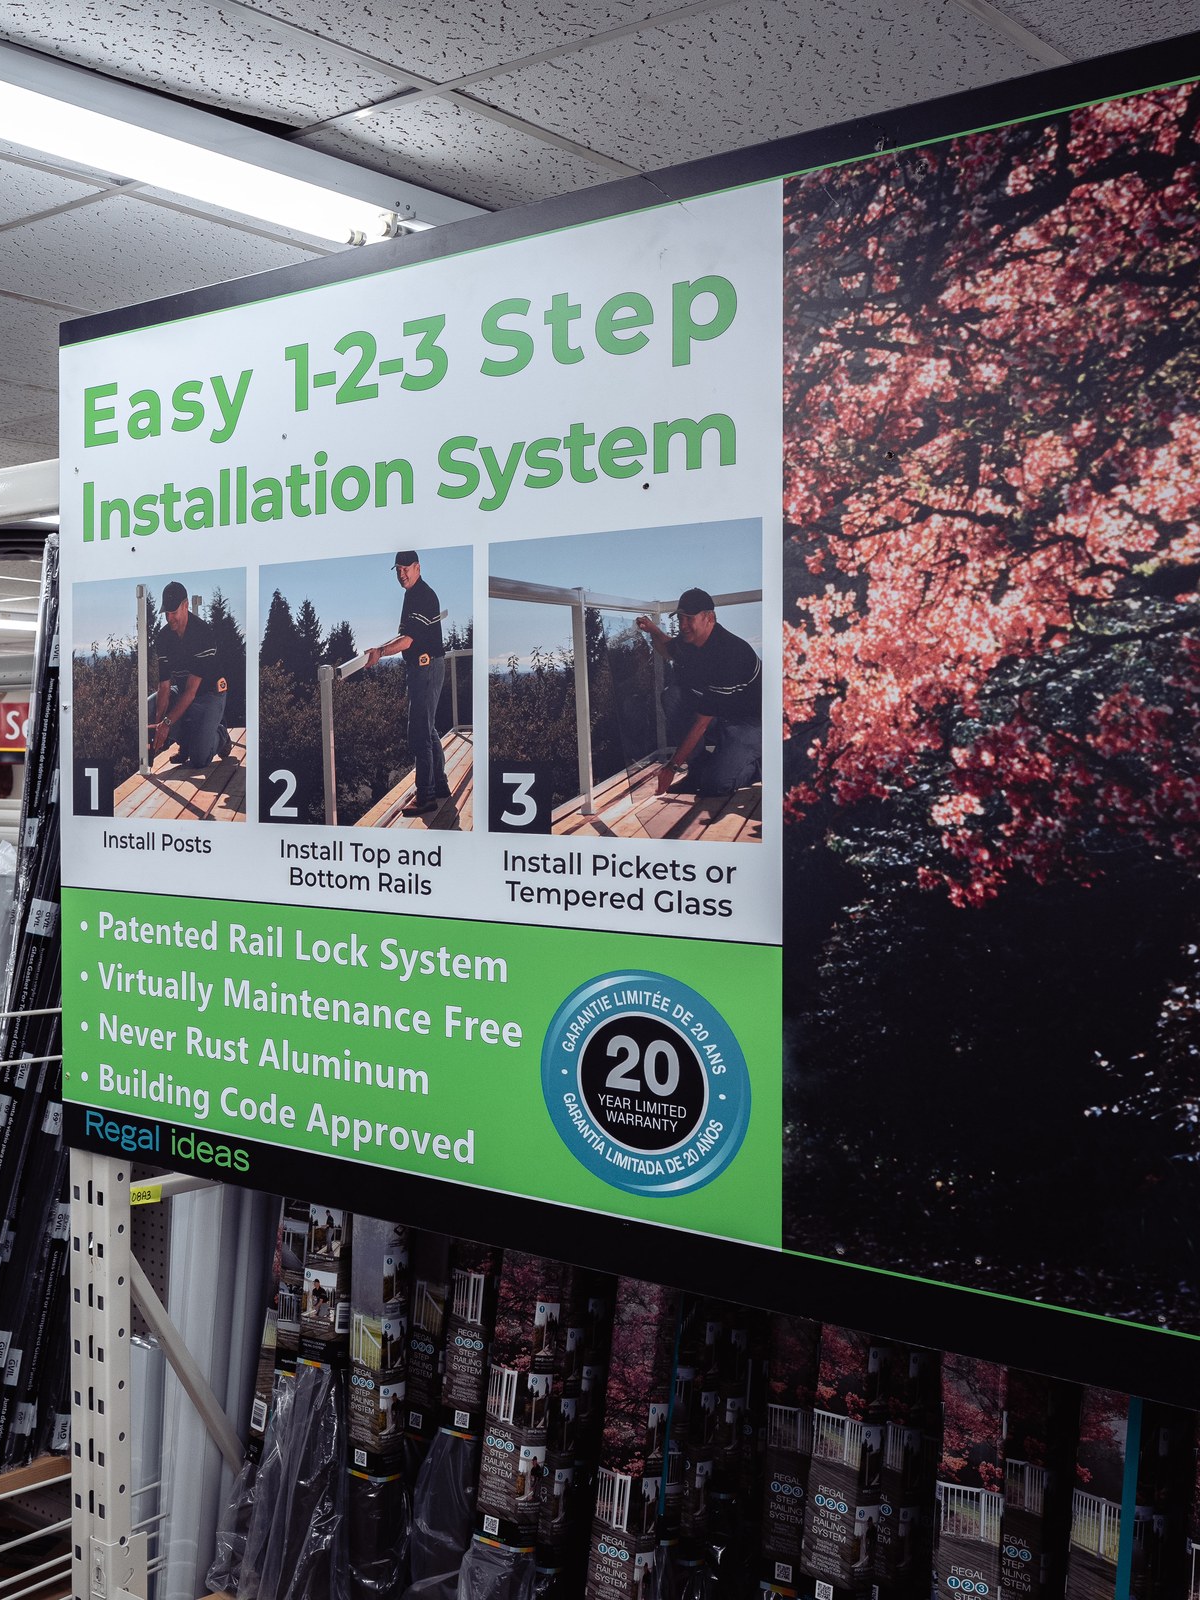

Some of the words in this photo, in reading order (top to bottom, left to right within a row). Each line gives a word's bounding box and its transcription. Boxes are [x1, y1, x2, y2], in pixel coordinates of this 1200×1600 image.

[85, 371, 252, 448] Easy
[285, 315, 448, 411] 1-2-3
[482, 277, 736, 376] Step
[84, 452, 413, 541] Installation
[439, 415, 735, 510] System
[47, 677, 55, 693] Junta
[46, 693, 53, 701] de
[43, 701, 52, 718] vidrio
[41, 718, 49, 732] para
[39, 732, 48, 754] paneles
[39, 754, 46, 763] de
[37, 762, 45, 780] vidrio
[85, 766, 101, 812] 1
[268, 770, 299, 818] 2
[501, 772, 538, 827] 3
[104, 831, 154, 850] Install
[162, 834, 211, 853] Posts
[281, 840, 342, 861] Install
[350, 843, 390, 868] Top
[398, 846, 441, 866] and
[504, 850, 581, 875] Install
[593, 854, 696, 881] Pickets
[706, 866, 736, 884] or
[290, 867, 369, 891] Bottom
[379, 873, 431, 895] Rails
[506, 881, 643, 911] Tempered
[655, 890, 732, 917] Glass
[33, 910, 42, 928] GVIL
[42, 911, 51, 929] GVIL
[27, 946, 37, 964] Glass
[100, 912, 217, 950] Patented
[230, 924, 282, 957] Rail
[297, 930, 368, 967] Lock
[381, 939, 507, 982] System
[22, 965, 34, 989] Gasket
[20, 990, 29, 1002] For
[98, 962, 213, 1007] Virtually
[225, 976, 430, 1034] Maintenance
[446, 1006, 522, 1047] Free
[562, 995, 613, 1052] GARANTIE
[614, 990, 671, 1012] LIMITÉE
[672, 1004, 694, 1025] DE
[690, 1023, 709, 1041] 20
[703, 1044, 727, 1075] ANS
[8, 1039, 19, 1059] Glass
[100, 1013, 176, 1051] Never
[187, 1027, 248, 1064] Rust
[259, 1039, 428, 1098] Aluminum
[18, 1063, 27, 1081] GVIL
[605, 1034, 680, 1096] 20
[7, 1099, 18, 1117] Junta
[598, 1094, 631, 1110] YEAR
[635, 1101, 686, 1119] LIMITED
[6, 1118, 14, 1126] de
[99, 1066, 209, 1121] Building
[221, 1087, 295, 1128] Code
[304, 1103, 474, 1167] Approved
[606, 1109, 678, 1132] WARRANTY
[2, 1126, 13, 1144] vidrio
[83, 1109, 163, 1157] Regal
[168, 1128, 253, 1175] ideas
[563, 1092, 604, 1155] GARANTÍA
[606, 1147, 665, 1175] LIMITADA
[665, 1158, 685, 1174] DE
[683, 1148, 699, 1167] 20
[699, 1119, 724, 1156] AÑOS
[54, 1214, 64, 1232] GVIL
[52, 1251, 60, 1270] Glass
[36, 1311, 48, 1346] Tempered
[457, 1328, 481, 1339] REGAL
[453, 1355, 482, 1367] RAILING
[459, 1348, 477, 1357] STEP
[6, 1359, 16, 1378] GVIL
[353, 1366, 373, 1379] REGAL
[452, 1363, 482, 1375] SYSTEM
[351, 1394, 374, 1407] RAILING
[354, 1388, 370, 1397] STEP
[0, 1397, 9, 1415] Junta
[350, 1401, 375, 1416] SYSTEM
[59, 1421, 67, 1440] GVIL
[489, 1427, 513, 1440] REGAL
[489, 1448, 509, 1459] STEP
[483, 1464, 512, 1479] SYSTEM
[484, 1456, 513, 1470] RAILING
[774, 1472, 801, 1486] REGAL
[776, 1495, 797, 1504] STEP
[818, 1485, 846, 1500] REGAL
[769, 1510, 803, 1525] SYSTEM
[770, 1502, 802, 1515] RAILING
[819, 1508, 842, 1521] STEP
[813, 1516, 847, 1534] RAILING
[601, 1534, 628, 1549] REGAL
[812, 1525, 847, 1544] SYSTEM
[1003, 1533, 1030, 1549] EGAL
[602, 1556, 623, 1568] STEP
[1002, 1545, 1032, 1561] 23
[594, 1572, 628, 1589] SYSTEM
[596, 1564, 628, 1580] RAILING
[951, 1565, 985, 1580] REGAL
[1001, 1576, 1031, 1593] STEM
